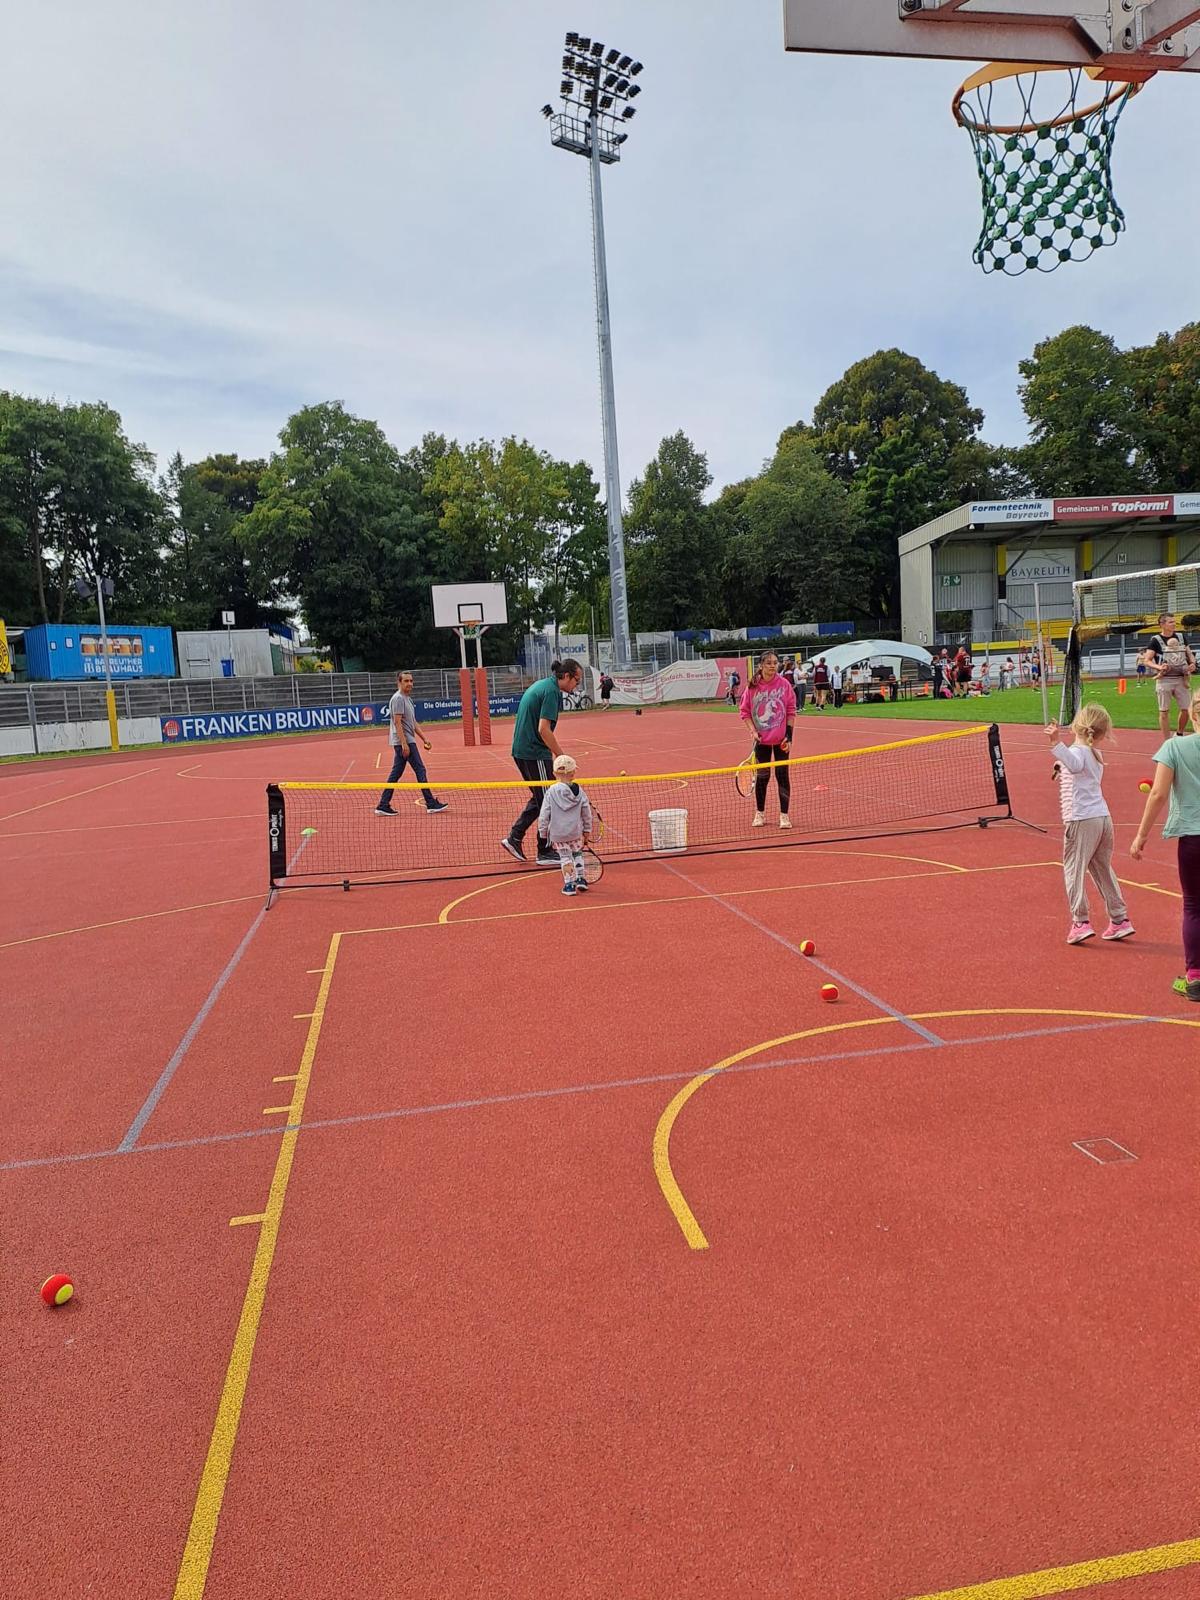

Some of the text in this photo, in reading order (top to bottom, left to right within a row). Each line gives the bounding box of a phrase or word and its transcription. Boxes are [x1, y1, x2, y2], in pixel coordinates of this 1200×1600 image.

[972, 502, 1042, 512] Formentechnik
[1057, 500, 1170, 513] Gemeinsam in Topform!
[1006, 511, 1050, 520] Bayreuth
[1011, 566, 1070, 577] BAYREUTH
[225, 612, 233, 623] L
[95, 657, 143, 666] BAREUTHER
[182, 707, 360, 737] FRANKEN BRUNNEN
